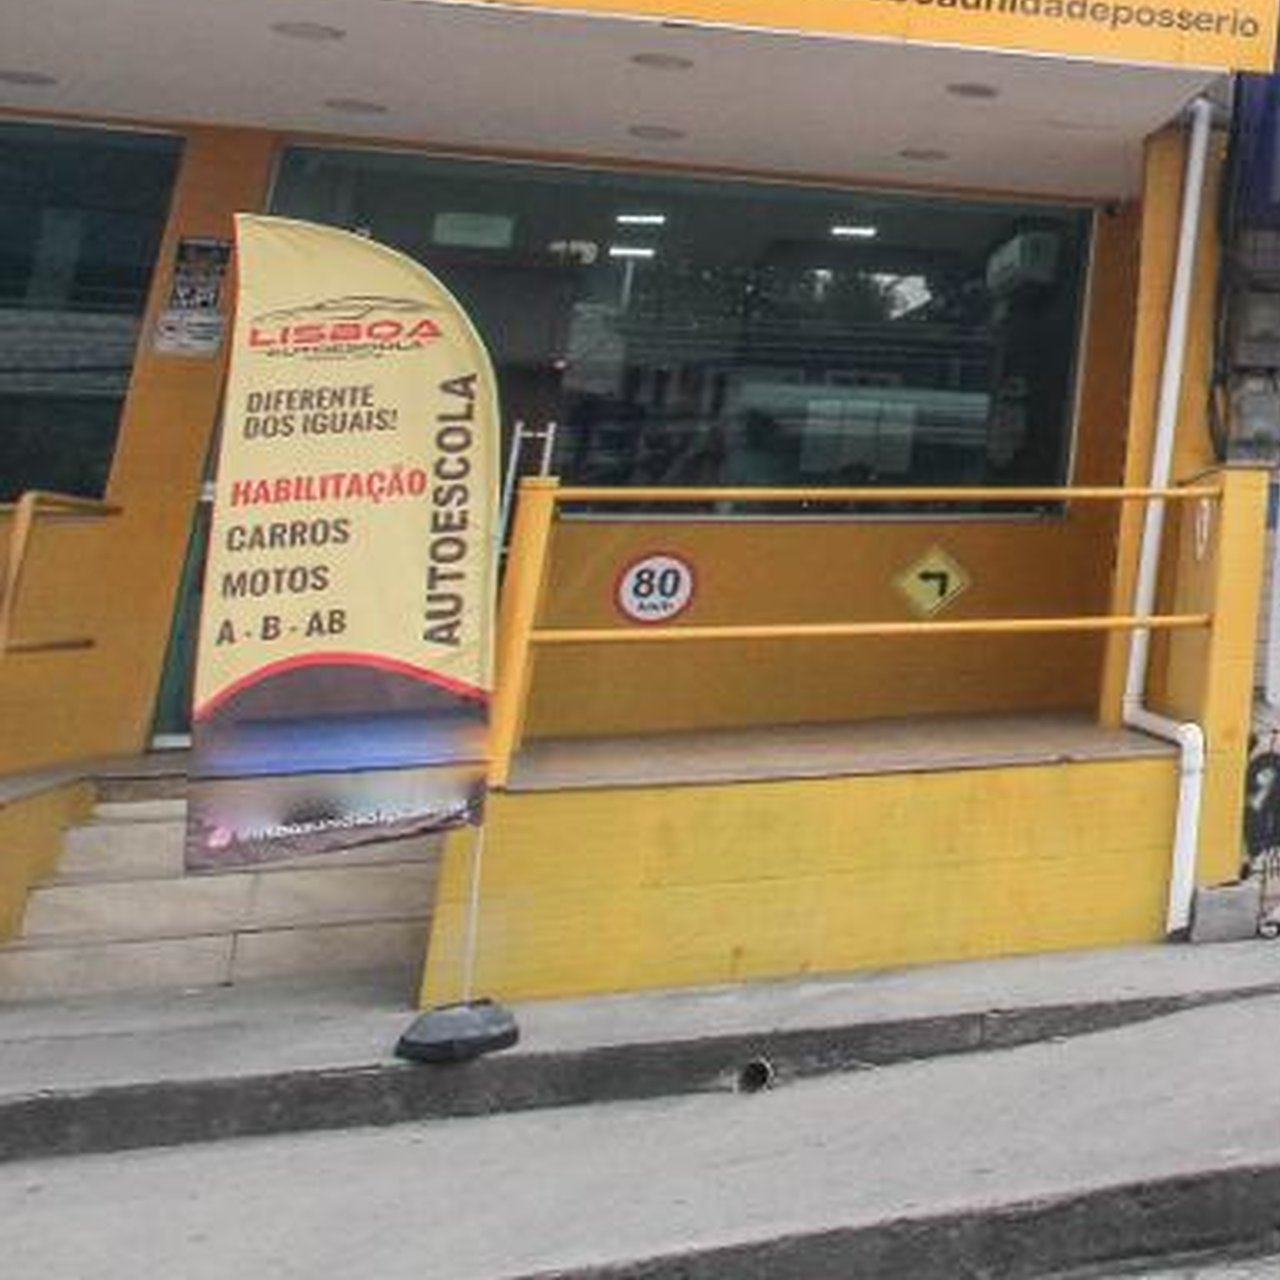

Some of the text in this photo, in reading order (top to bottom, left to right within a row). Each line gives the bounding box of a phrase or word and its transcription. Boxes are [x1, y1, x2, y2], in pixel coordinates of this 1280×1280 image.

[249, 319, 443, 347] LISBOA
[246, 384, 375, 413] DIFERENTE
[243, 409, 398, 439] DOS IGUAIS!
[230, 467, 427, 507] HABILITAÇÃO
[423, 373, 478, 648] AUTOESCOLA
[226, 518, 350, 552] CARROS
[221, 565, 329, 599] MOTOS
[633, 567, 681, 598] 80
[215, 619, 236, 645] A
[261, 616, 281, 641] B
[305, 609, 347, 637] AB
